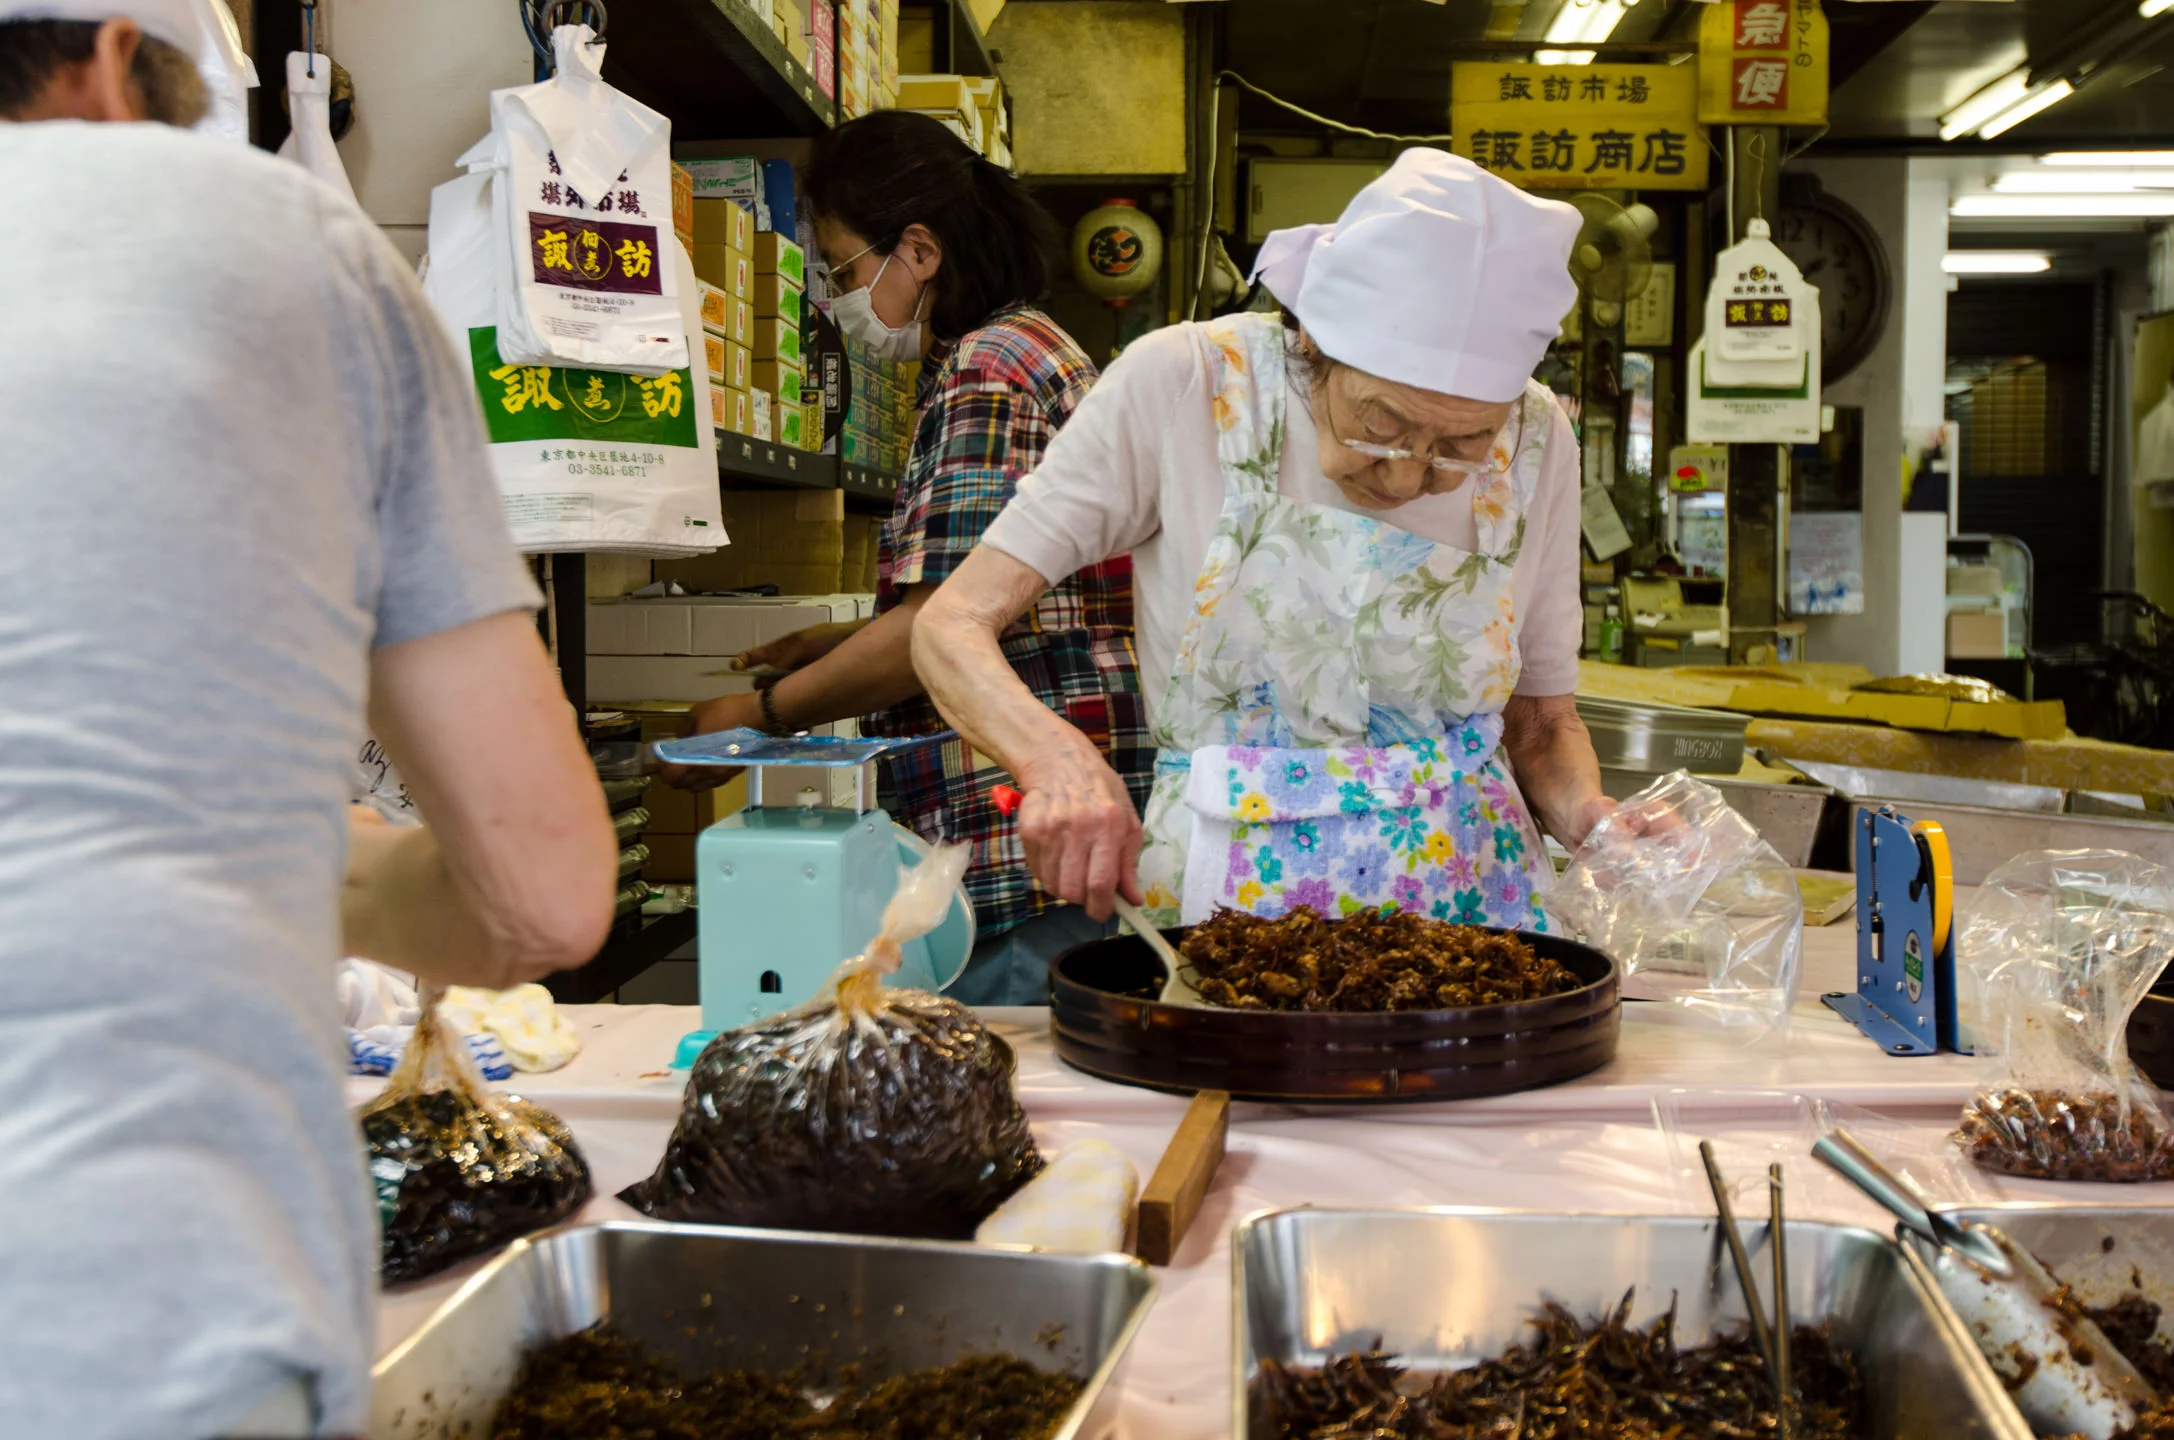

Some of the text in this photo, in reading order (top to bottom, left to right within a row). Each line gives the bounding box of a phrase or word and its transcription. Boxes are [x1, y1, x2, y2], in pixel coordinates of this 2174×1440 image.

[1794, 0, 1812, 68] ヤマトの
[1499, 72, 1652, 104] 諏訪市場
[1469, 128, 1688, 175] 諏訪商店
[567, 462, 647, 478] 03-3541-6871
